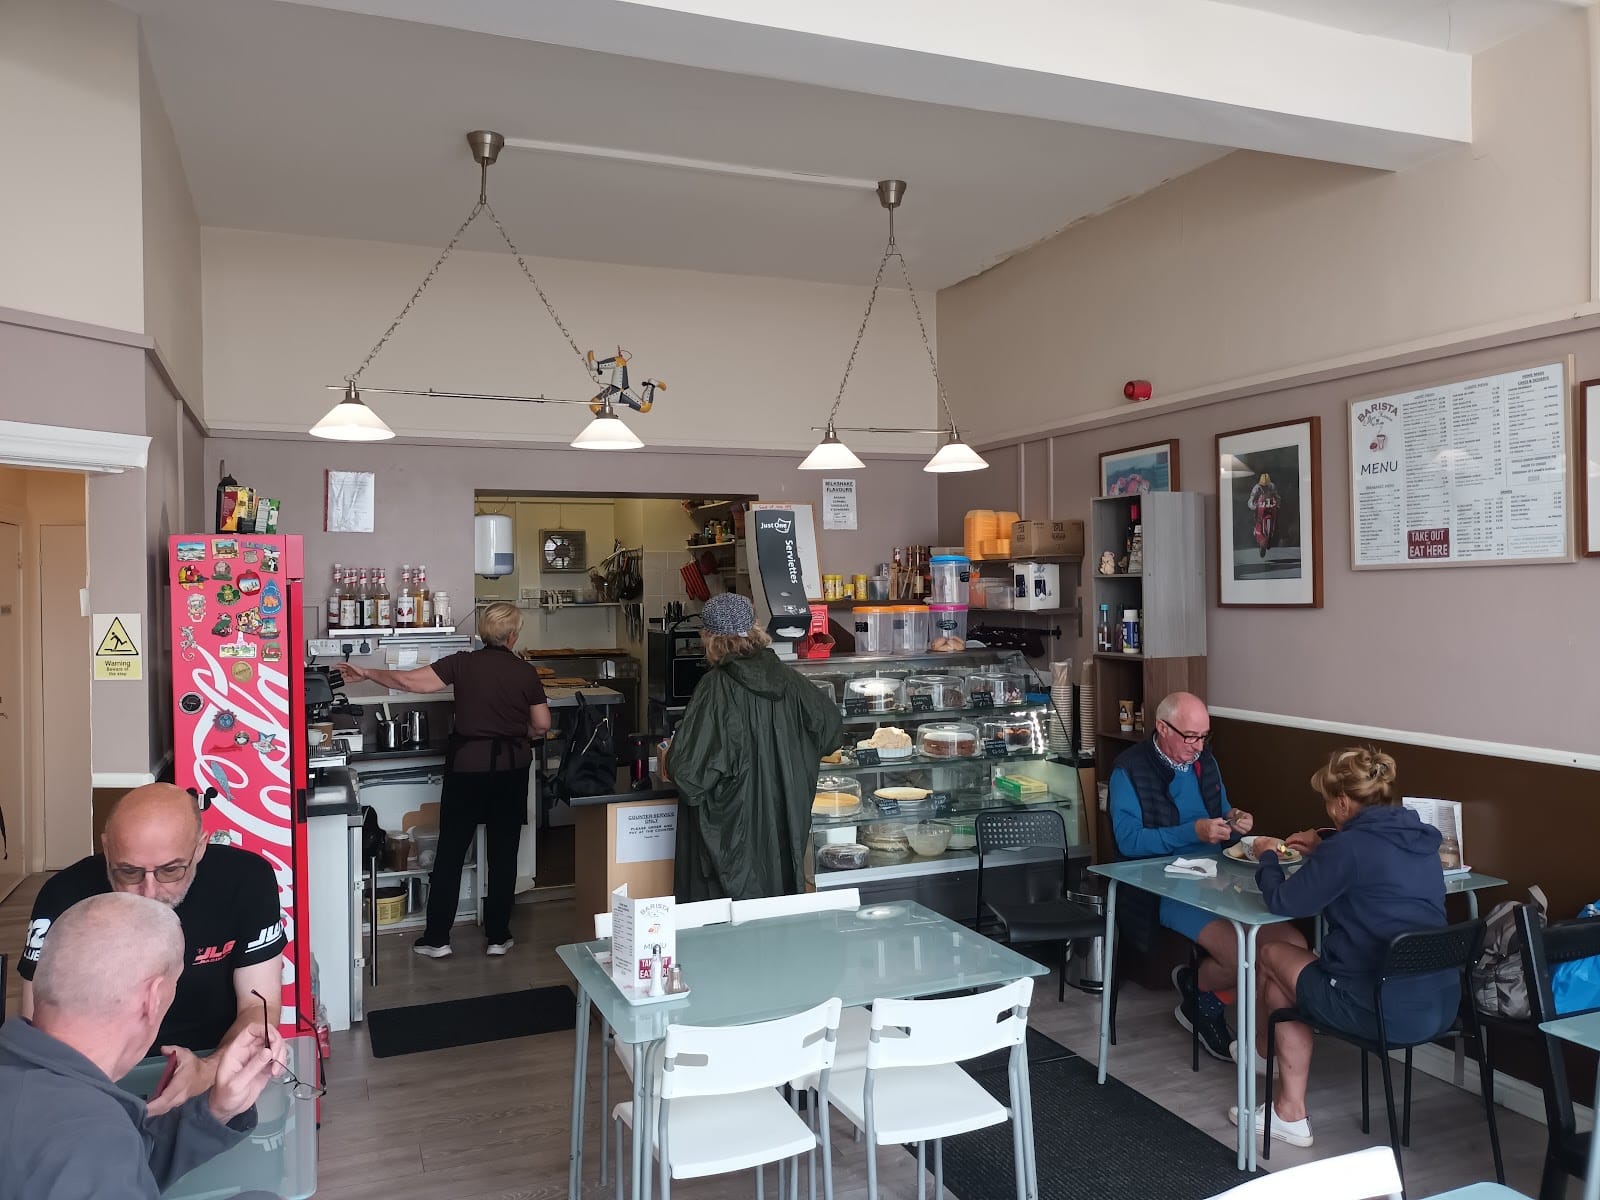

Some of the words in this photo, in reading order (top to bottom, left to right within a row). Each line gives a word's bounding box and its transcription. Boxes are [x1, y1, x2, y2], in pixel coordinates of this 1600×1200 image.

[1357, 402, 1398, 422] BARISTA
[1360, 460, 1398, 476] MENU
[1411, 531, 1429, 542] TAKE
[1430, 530, 1445, 541] OUT
[1409, 546, 1425, 557] EAT
[1426, 544, 1448, 556] HERE
[785, 539, 798, 584] Serviettes
[105, 660, 131, 668] Warning
[640, 903, 670, 915] BARISTA
[641, 959, 652, 967] TAK
